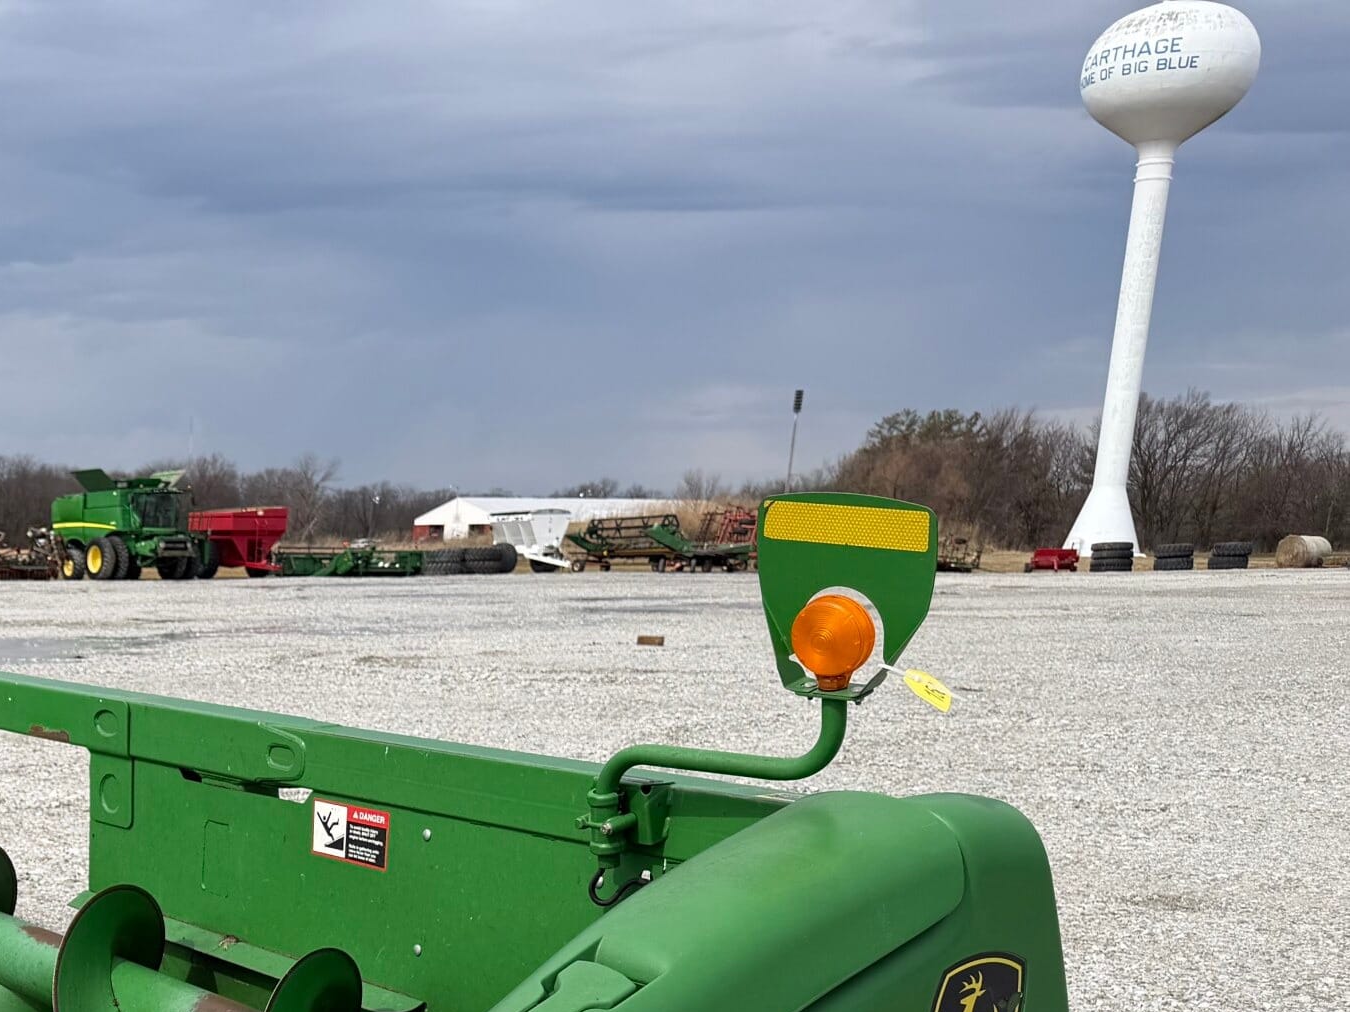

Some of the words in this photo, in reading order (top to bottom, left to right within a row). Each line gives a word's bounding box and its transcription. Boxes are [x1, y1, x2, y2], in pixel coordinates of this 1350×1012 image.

[1084, 37, 1183, 72] CARTHAGE
[1081, 72, 1096, 89] OME
[1100, 66, 1115, 81] OF
[1121, 60, 1148, 76] BIG
[1156, 55, 1200, 71] BLUE
[359, 811, 385, 825] DANGER
